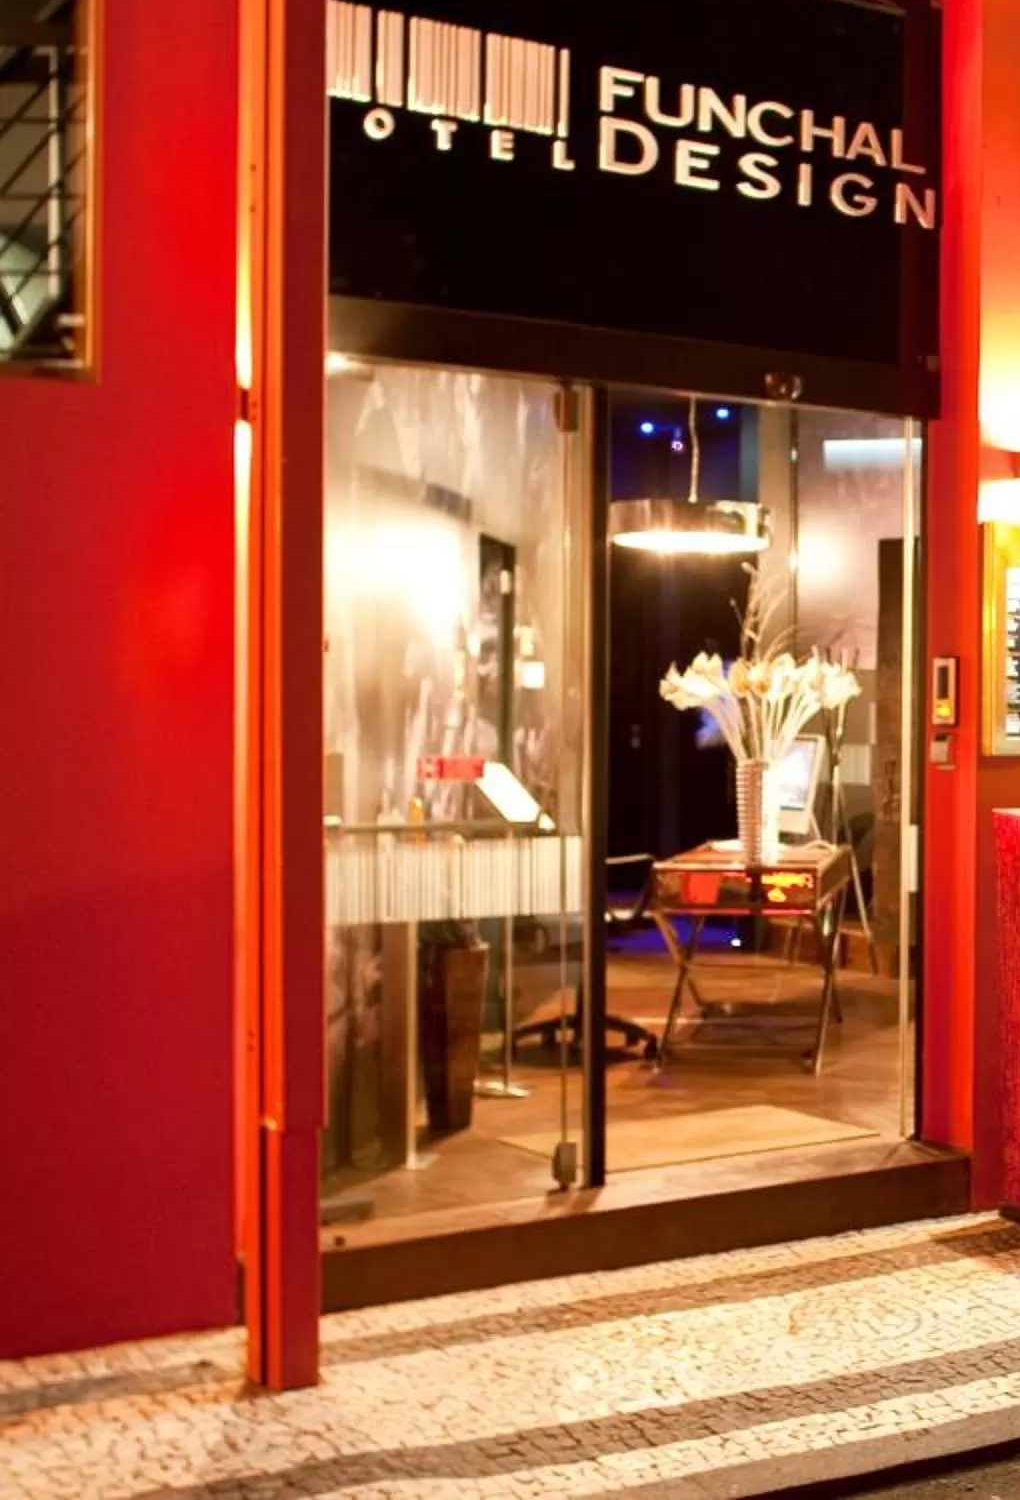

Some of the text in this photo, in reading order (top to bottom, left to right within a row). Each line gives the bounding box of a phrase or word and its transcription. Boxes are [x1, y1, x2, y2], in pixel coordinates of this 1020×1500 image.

[363, 108, 574, 171] OTEL
[598, 117, 936, 229] DESIGN
[600, 65, 926, 175] FUNCHAL
